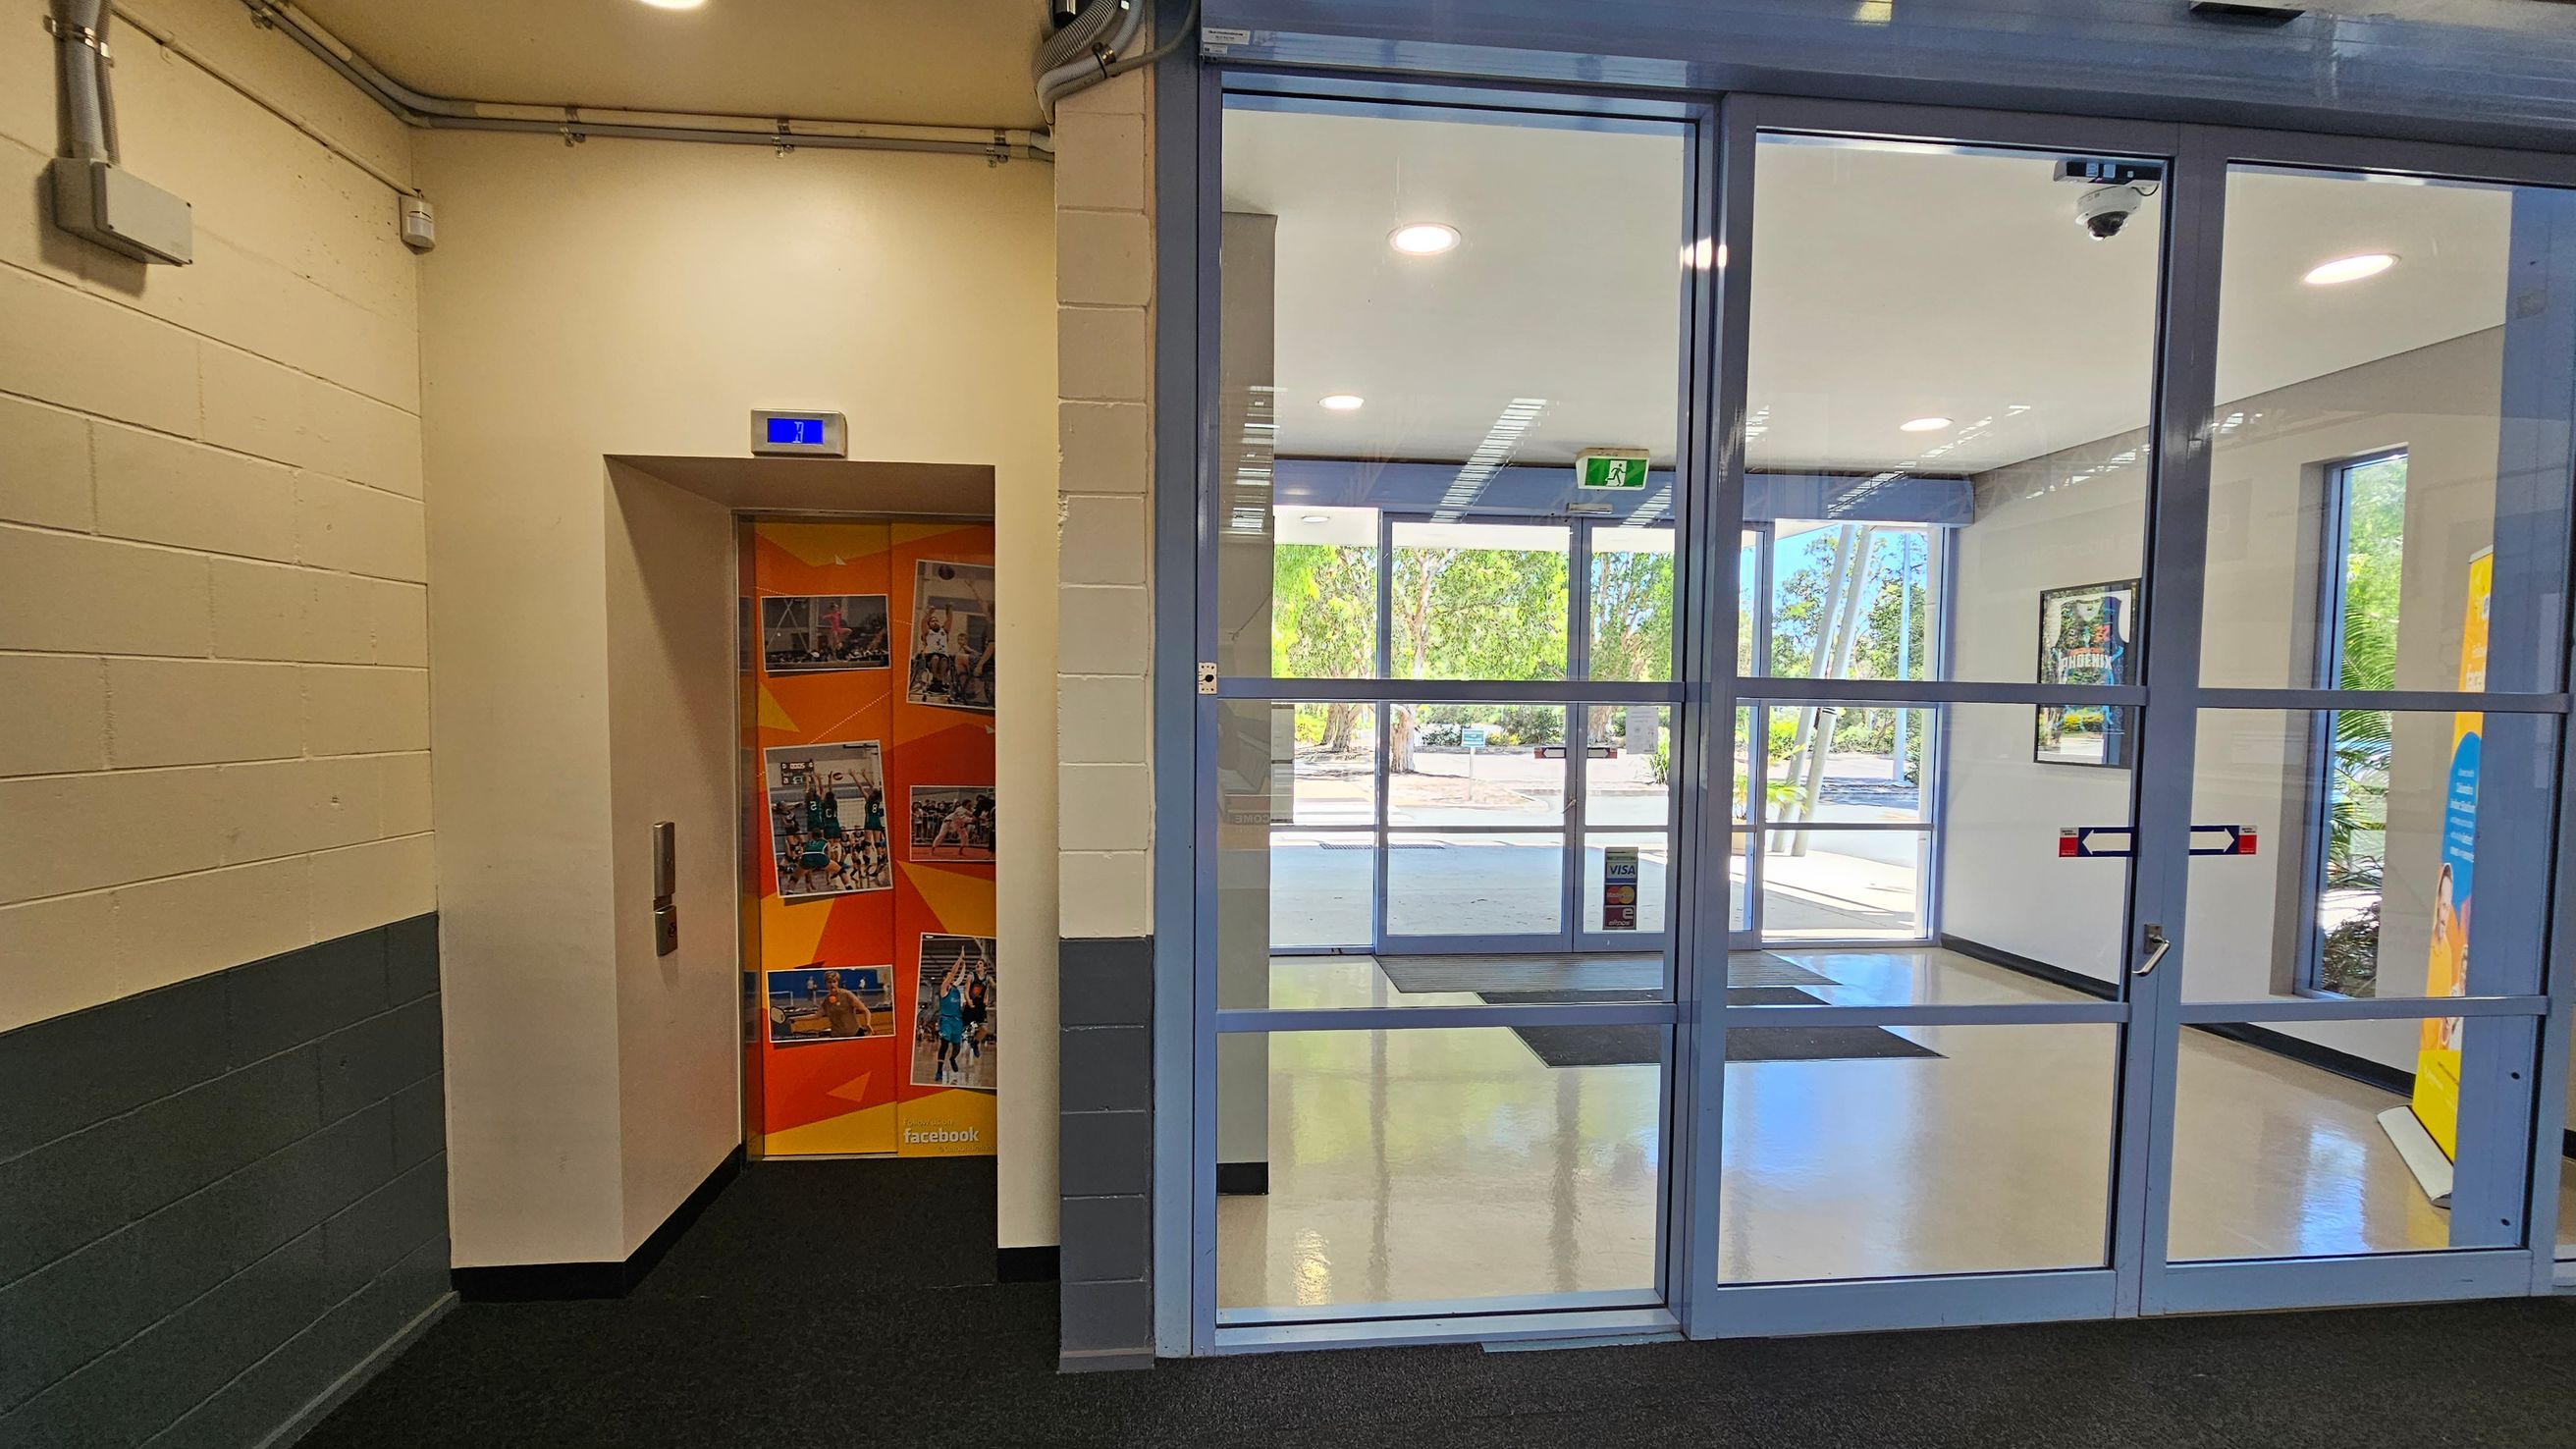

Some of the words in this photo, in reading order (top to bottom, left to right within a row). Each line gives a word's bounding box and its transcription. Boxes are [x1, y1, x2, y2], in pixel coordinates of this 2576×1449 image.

[2058, 653, 2113, 671] PHOENIX
[1610, 864, 1636, 875] VISA
[903, 1126, 980, 1144] facebook
